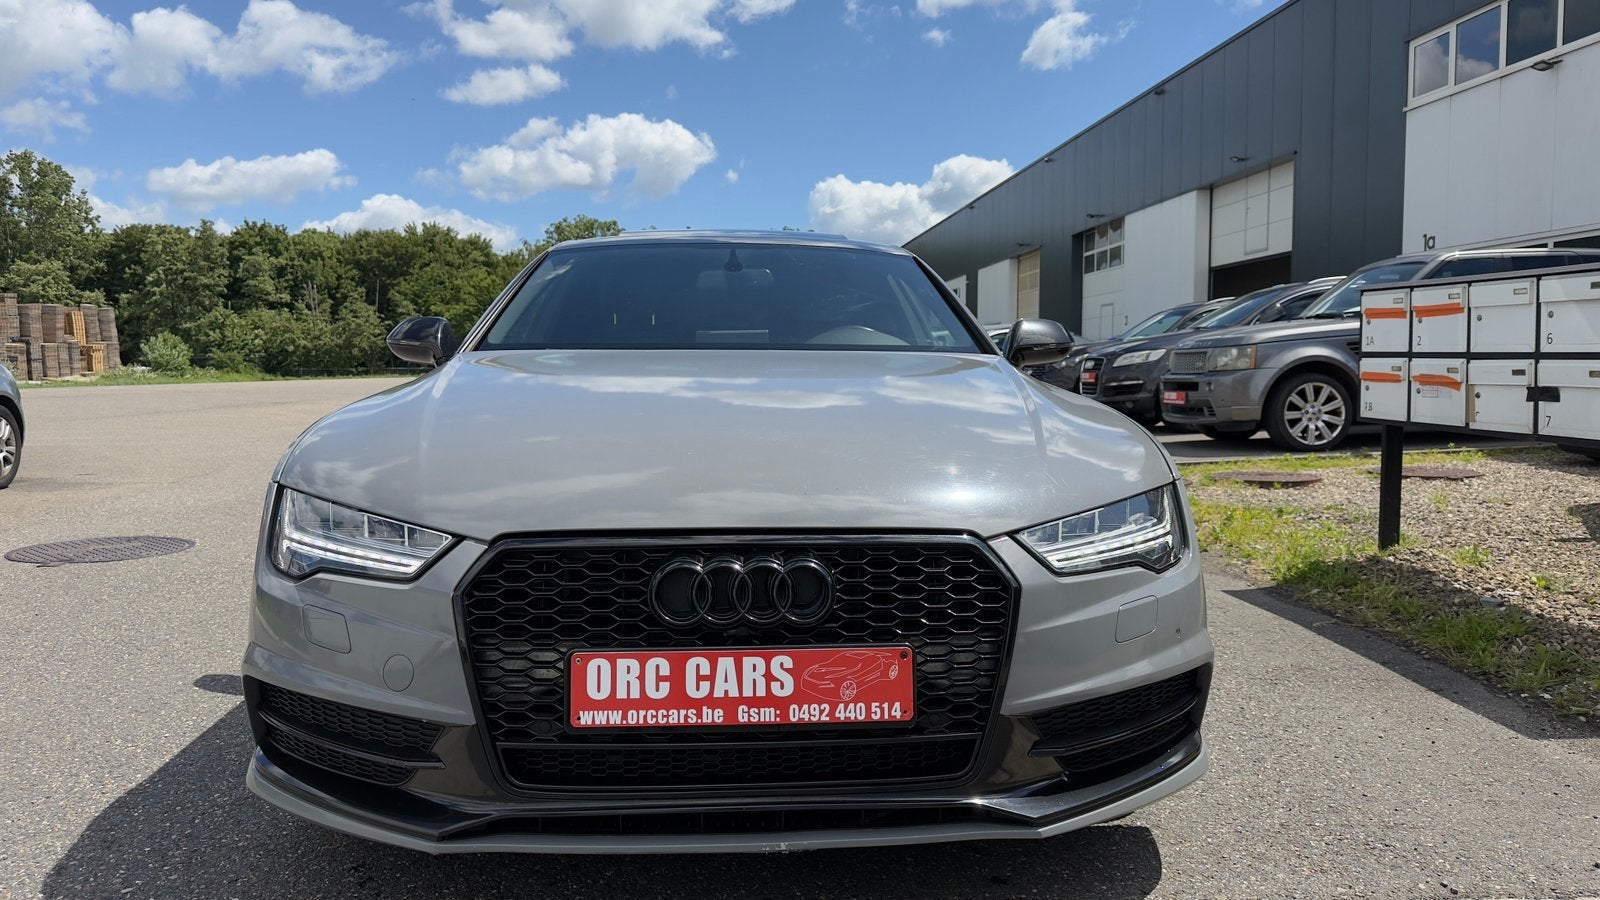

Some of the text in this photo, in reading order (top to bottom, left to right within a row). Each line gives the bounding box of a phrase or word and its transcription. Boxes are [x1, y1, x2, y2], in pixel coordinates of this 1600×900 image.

[1422, 233, 1436, 251] 1a
[1366, 336, 1375, 346] 1A
[1417, 335, 1422, 346] 2
[1546, 332, 1553, 344] 6
[1545, 415, 1552, 427] 7
[586, 655, 795, 700] ORC CARS
[579, 701, 901, 725] www.orccars.be Gsm: 0492 440 514
